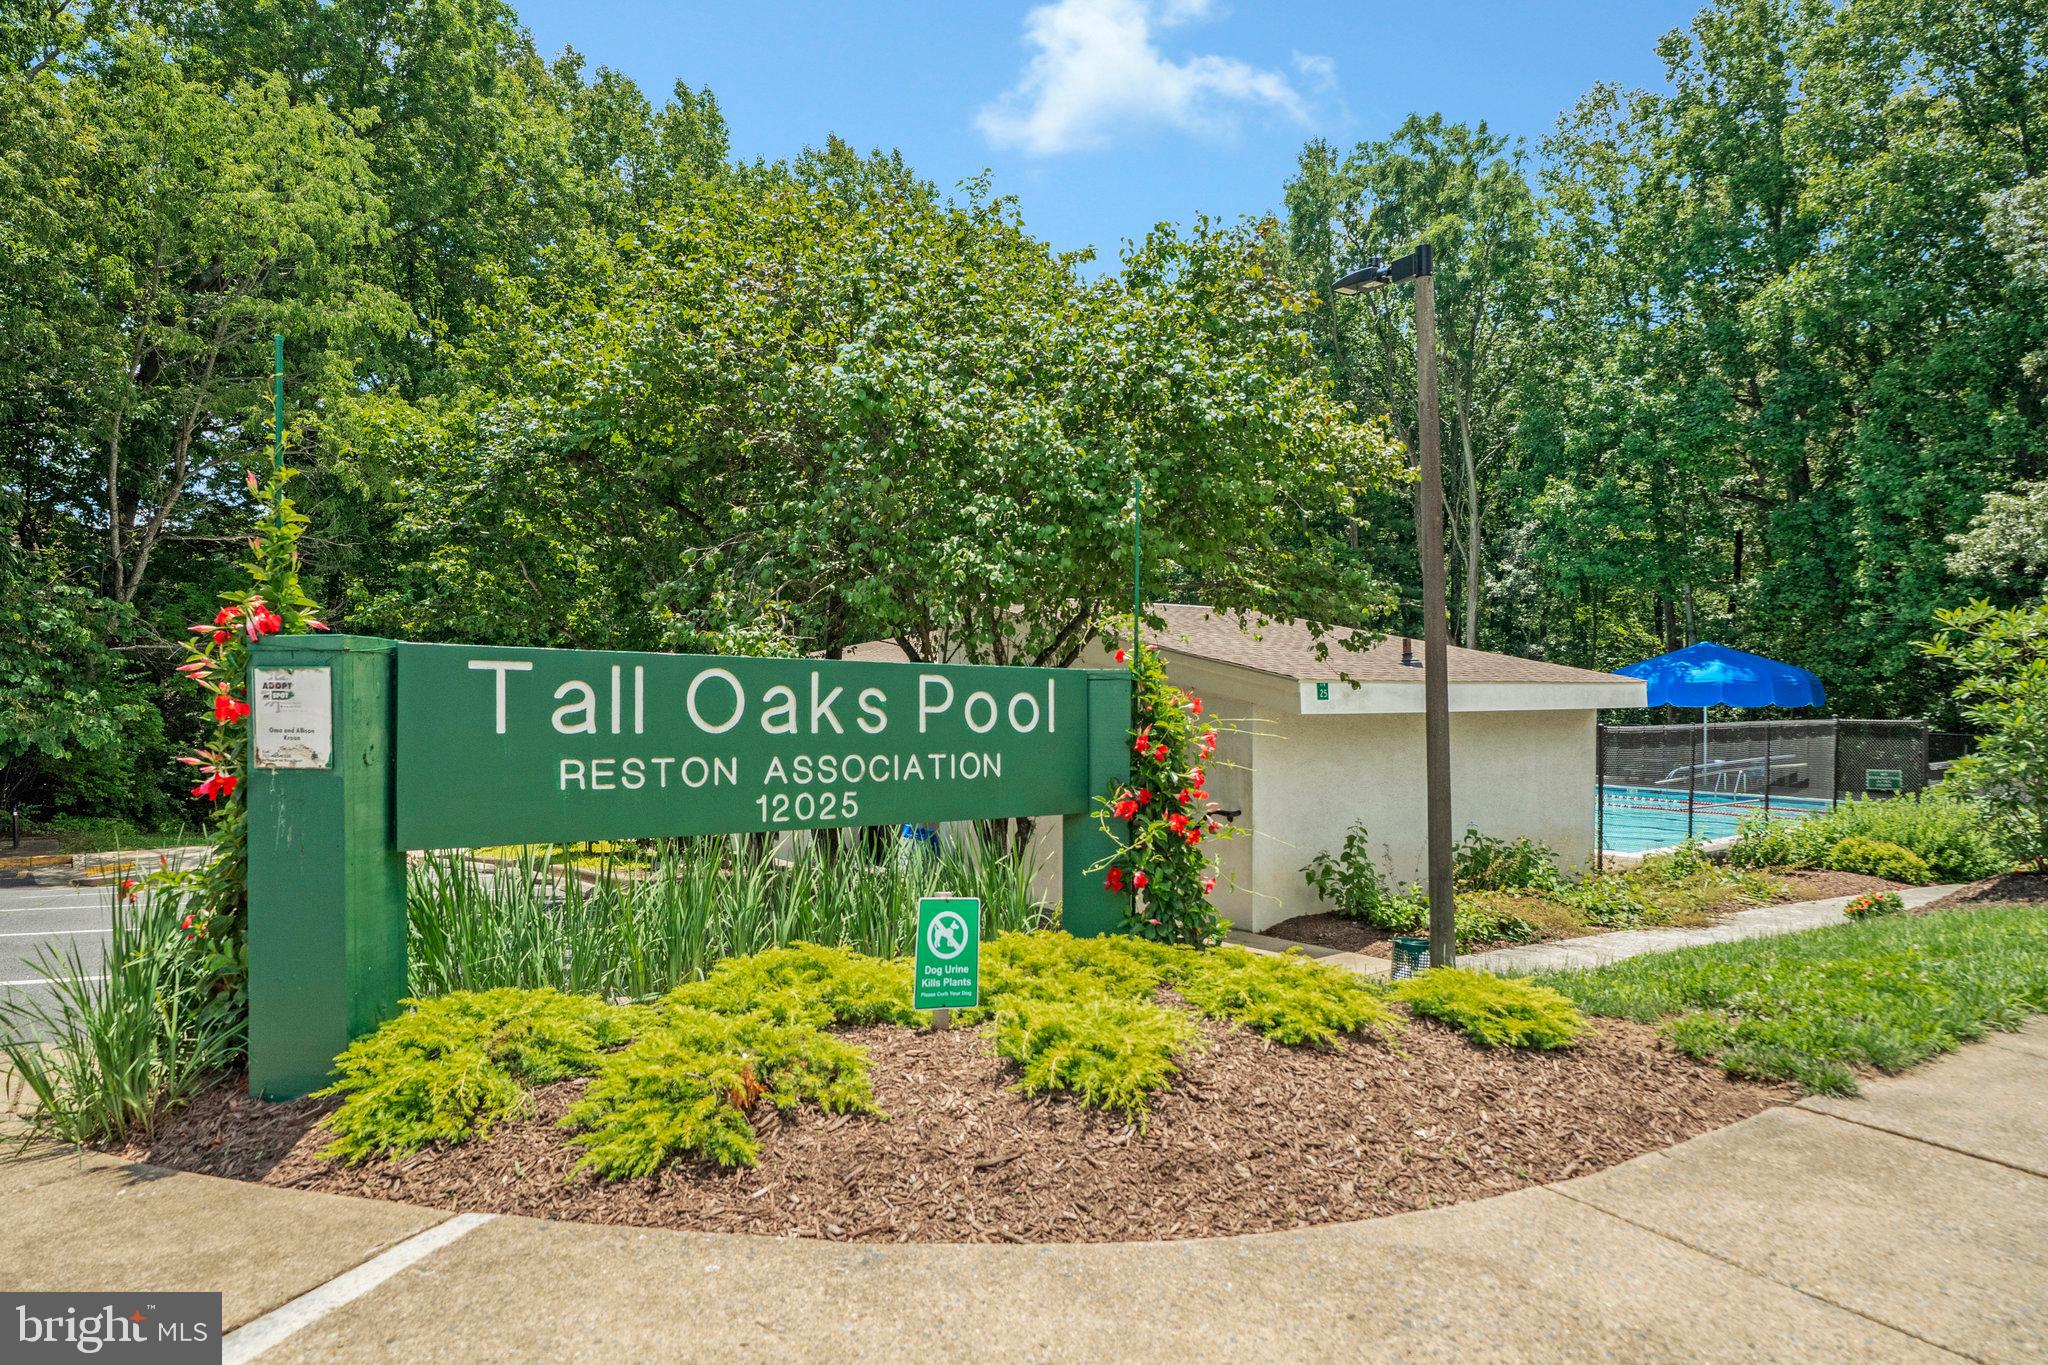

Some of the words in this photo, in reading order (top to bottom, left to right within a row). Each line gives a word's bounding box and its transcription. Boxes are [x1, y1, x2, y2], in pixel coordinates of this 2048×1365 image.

[467, 659, 645, 735] Tall
[686, 667, 888, 735] Oaks
[918, 674, 1056, 734] Pool
[1320, 689, 1328, 698] 25
[559, 756, 738, 791] RESTON
[763, 752, 1002, 785] ASSOCIATION
[755, 791, 860, 823] 12025
[924, 965, 943, 976] Dog
[944, 965, 969, 974] Urine
[921, 979, 941, 988] Kills
[944, 978, 971, 987] Plants
